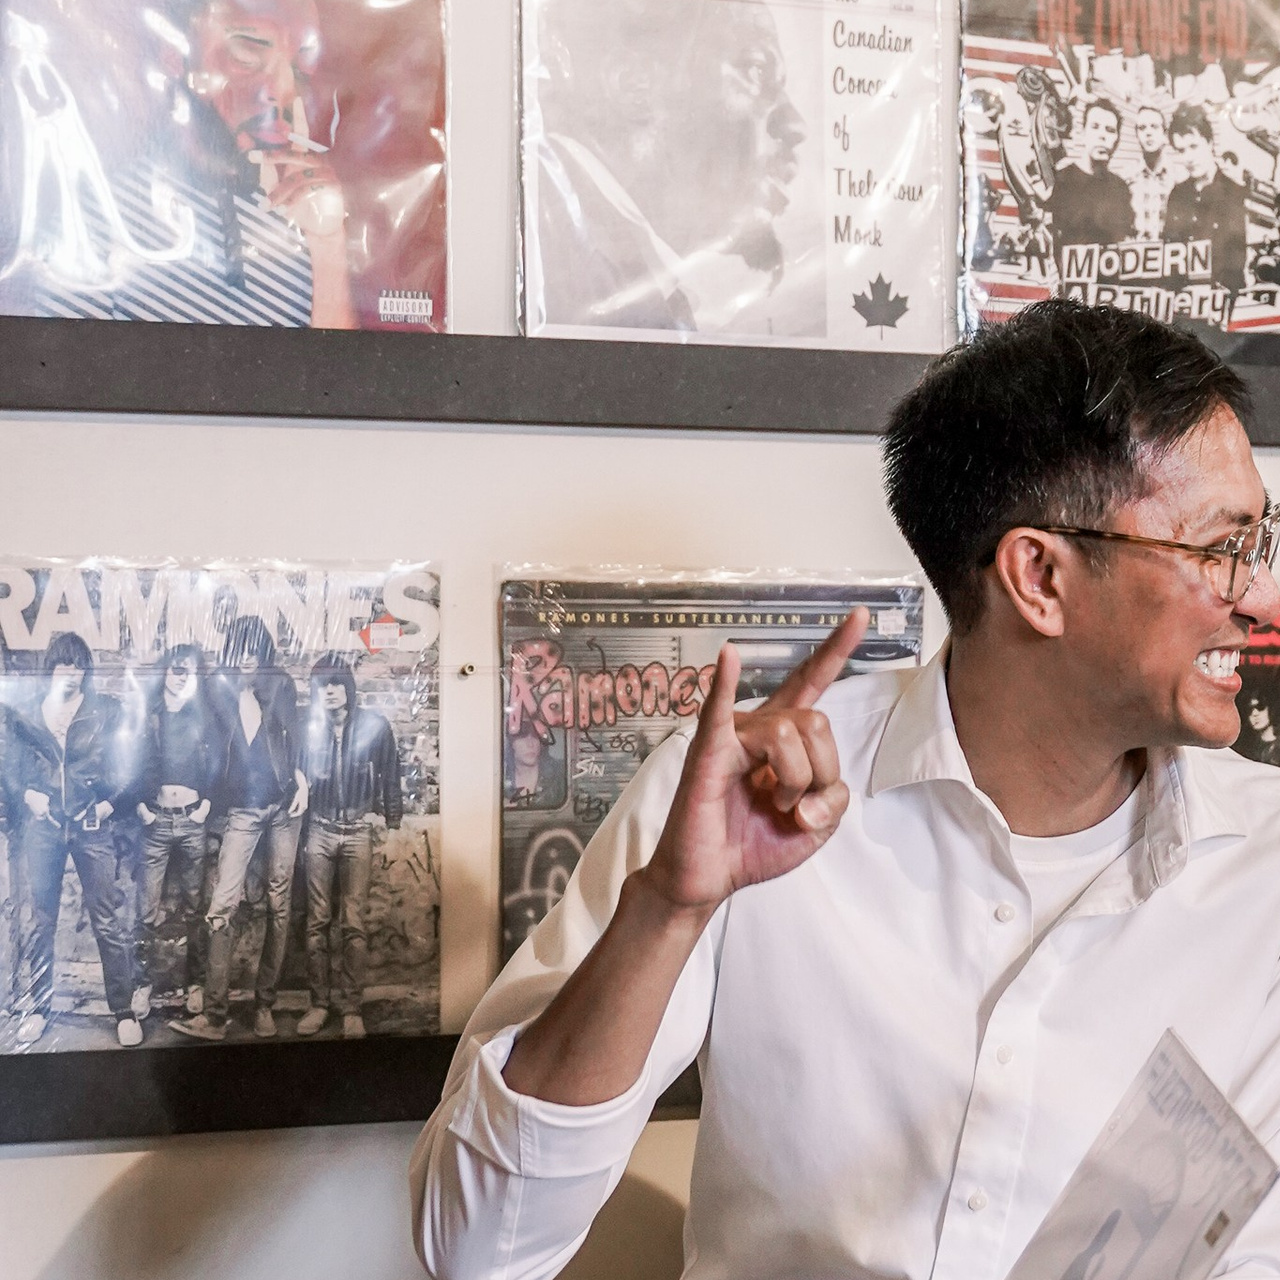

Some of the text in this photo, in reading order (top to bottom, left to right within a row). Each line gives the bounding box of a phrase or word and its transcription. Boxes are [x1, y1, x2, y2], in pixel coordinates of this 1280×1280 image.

[832, 19, 913, 53] Canadian
[833, 114, 850, 152] of
[1065, 241, 1211, 280] MODERN
[382, 300, 430, 314] ADVISORY
[0, 569, 441, 651] RAMONES
[538, 611, 630, 624] RAMONES
[653, 612, 801, 626] SUBTERRANEAN
